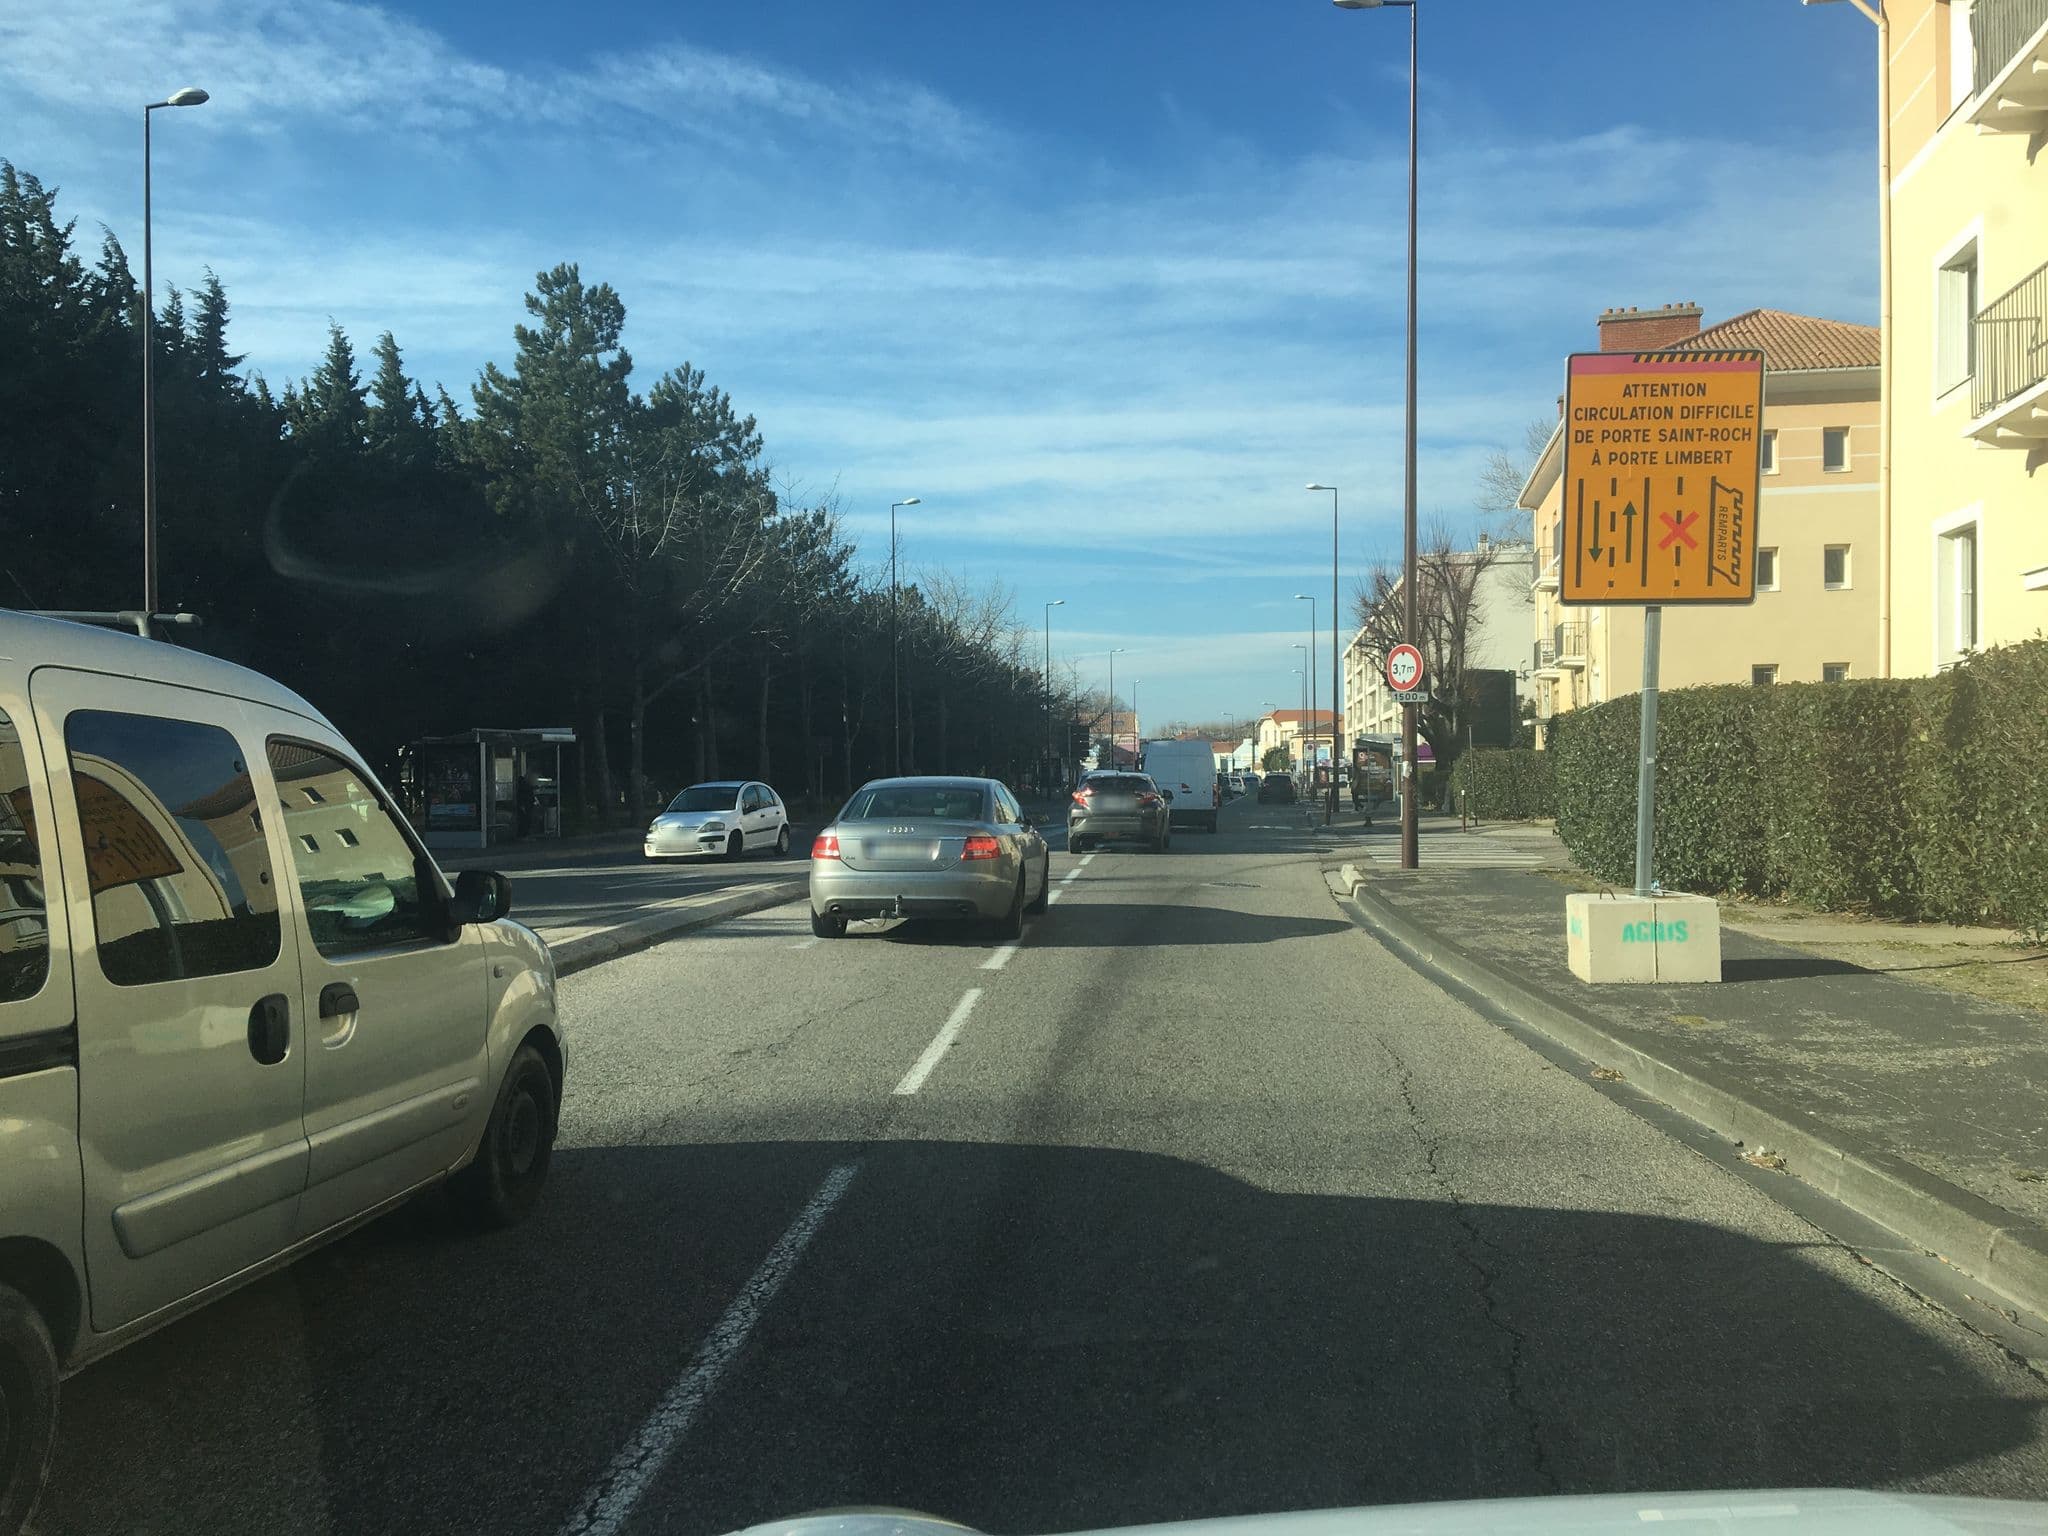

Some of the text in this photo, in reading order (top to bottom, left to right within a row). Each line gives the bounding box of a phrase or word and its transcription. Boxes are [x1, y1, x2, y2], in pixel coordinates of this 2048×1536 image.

[1622, 383, 1707, 398] ATTENTION
[1574, 405, 1754, 421] CIRCULATION DIFFICILE
[1575, 428, 1751, 443] DE PORTE SAINT-ROCH
[1592, 448, 1732, 465] À PORTE LIMBERT
[1718, 506, 1728, 561] REMPARTS
